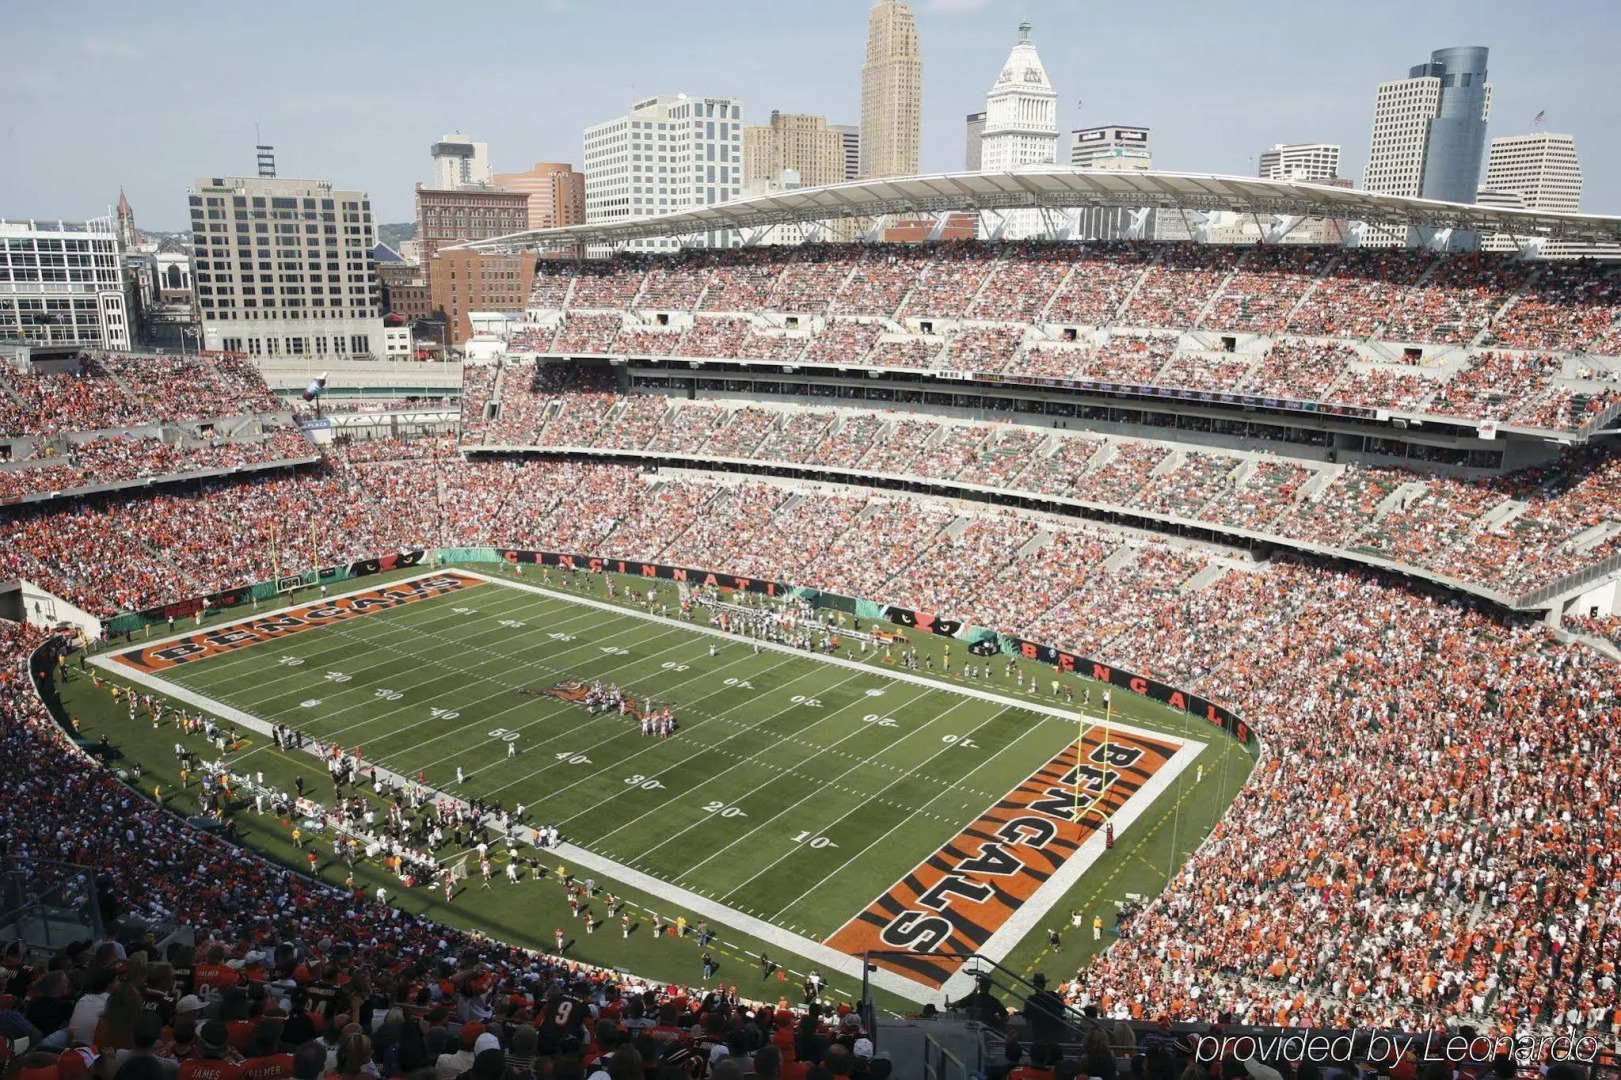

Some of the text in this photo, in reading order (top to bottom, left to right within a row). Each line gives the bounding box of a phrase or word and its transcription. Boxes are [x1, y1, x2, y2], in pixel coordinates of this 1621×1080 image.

[504, 551, 775, 597] CINCINNATI
[150, 577, 463, 661] BENGALS
[376, 688, 404, 701] 30
[1020, 642, 1248, 742] BENGALS
[430, 706, 460, 720] 40
[487, 728, 521, 742] 50
[554, 751, 588, 765] 40
[624, 774, 660, 790] 30
[701, 801, 741, 818] 20
[790, 830, 831, 849] 10
[879, 741, 1147, 953] BENGALS
[554, 1001, 574, 1025] 9
[191, 1068, 222, 1080] JAMES
